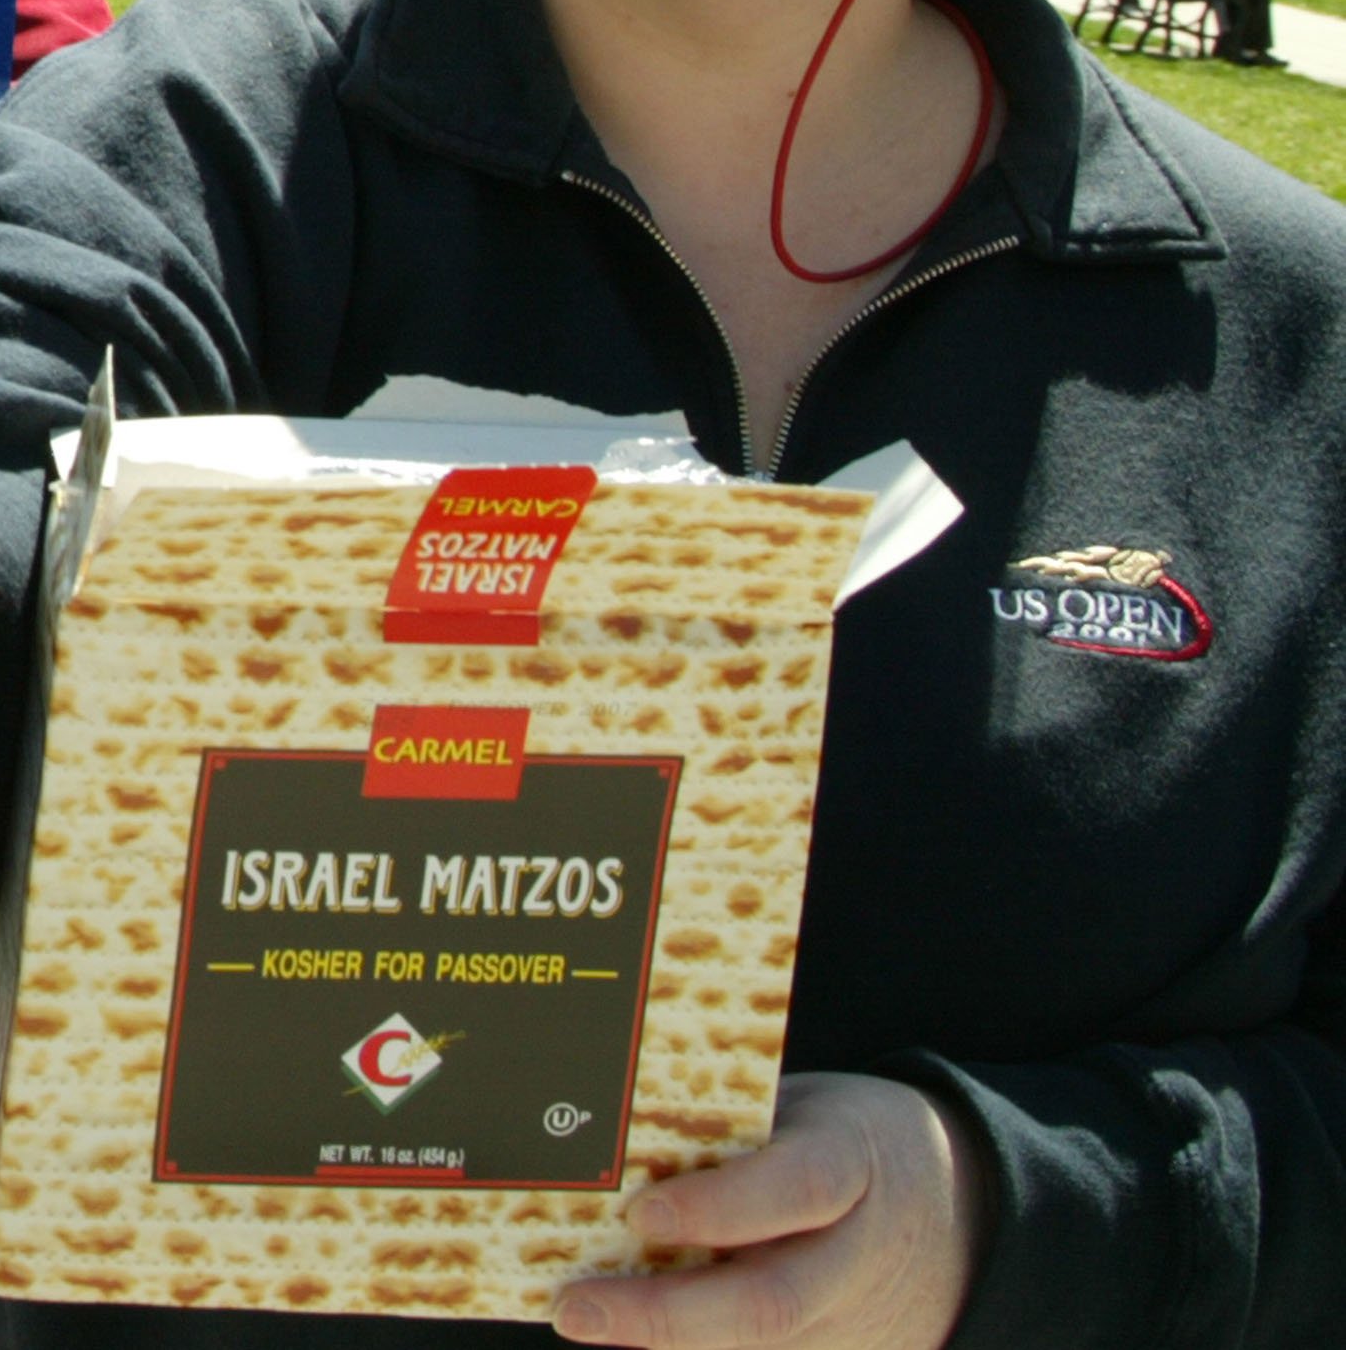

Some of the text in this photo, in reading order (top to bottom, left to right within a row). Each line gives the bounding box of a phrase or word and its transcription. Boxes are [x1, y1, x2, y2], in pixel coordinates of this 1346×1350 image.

[440, 497, 579, 517] CARMEL
[416, 532, 558, 560] MATZOS
[416, 562, 535, 595] ISRAEL
[989, 587, 1184, 645] US OPEN
[374, 736, 514, 765] CARMEL
[221, 850, 624, 918] ISRAEL MATZOS
[262, 949, 565, 984] KOSHER FOR PASSOVER
[319, 1144, 345, 1162] NET
[349, 1144, 374, 1164] WT.
[381, 1146, 396, 1164] 16
